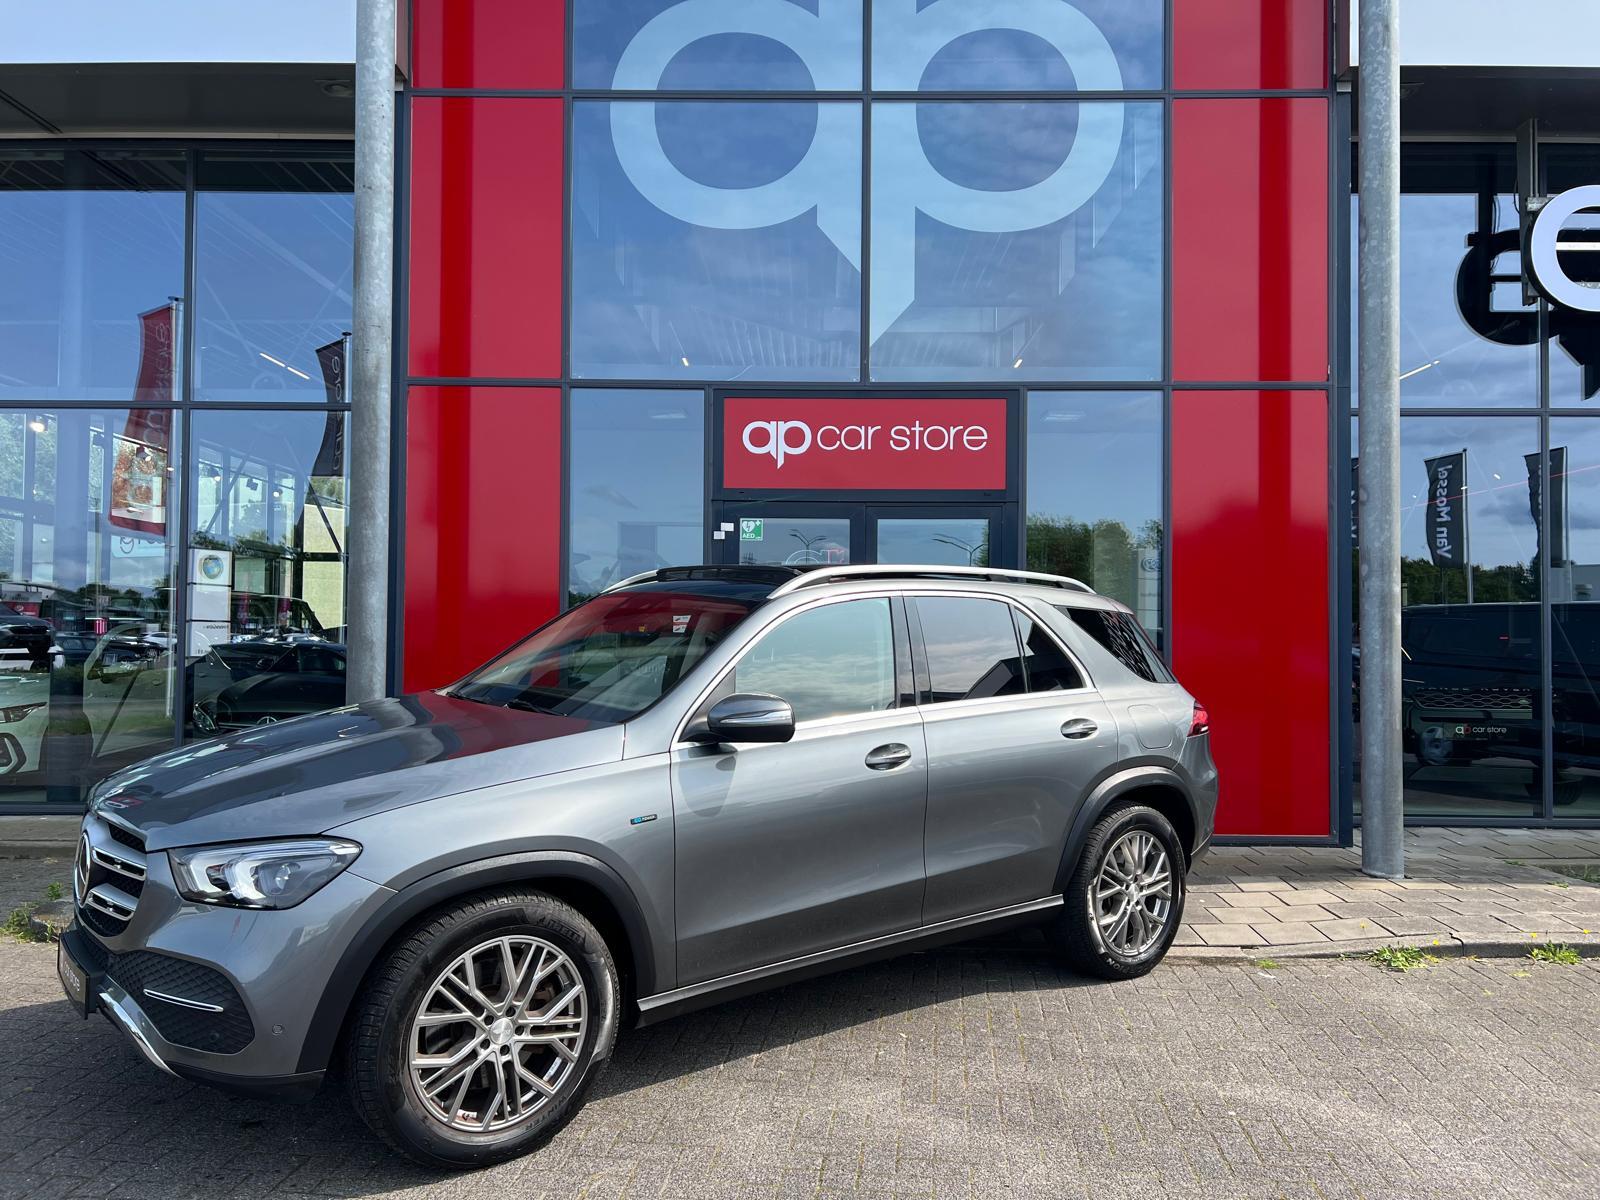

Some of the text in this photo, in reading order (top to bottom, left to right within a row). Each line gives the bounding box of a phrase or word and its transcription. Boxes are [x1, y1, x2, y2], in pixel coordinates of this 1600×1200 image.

[742, 420, 988, 470] ap car store
[1487, 725, 1507, 734] store
